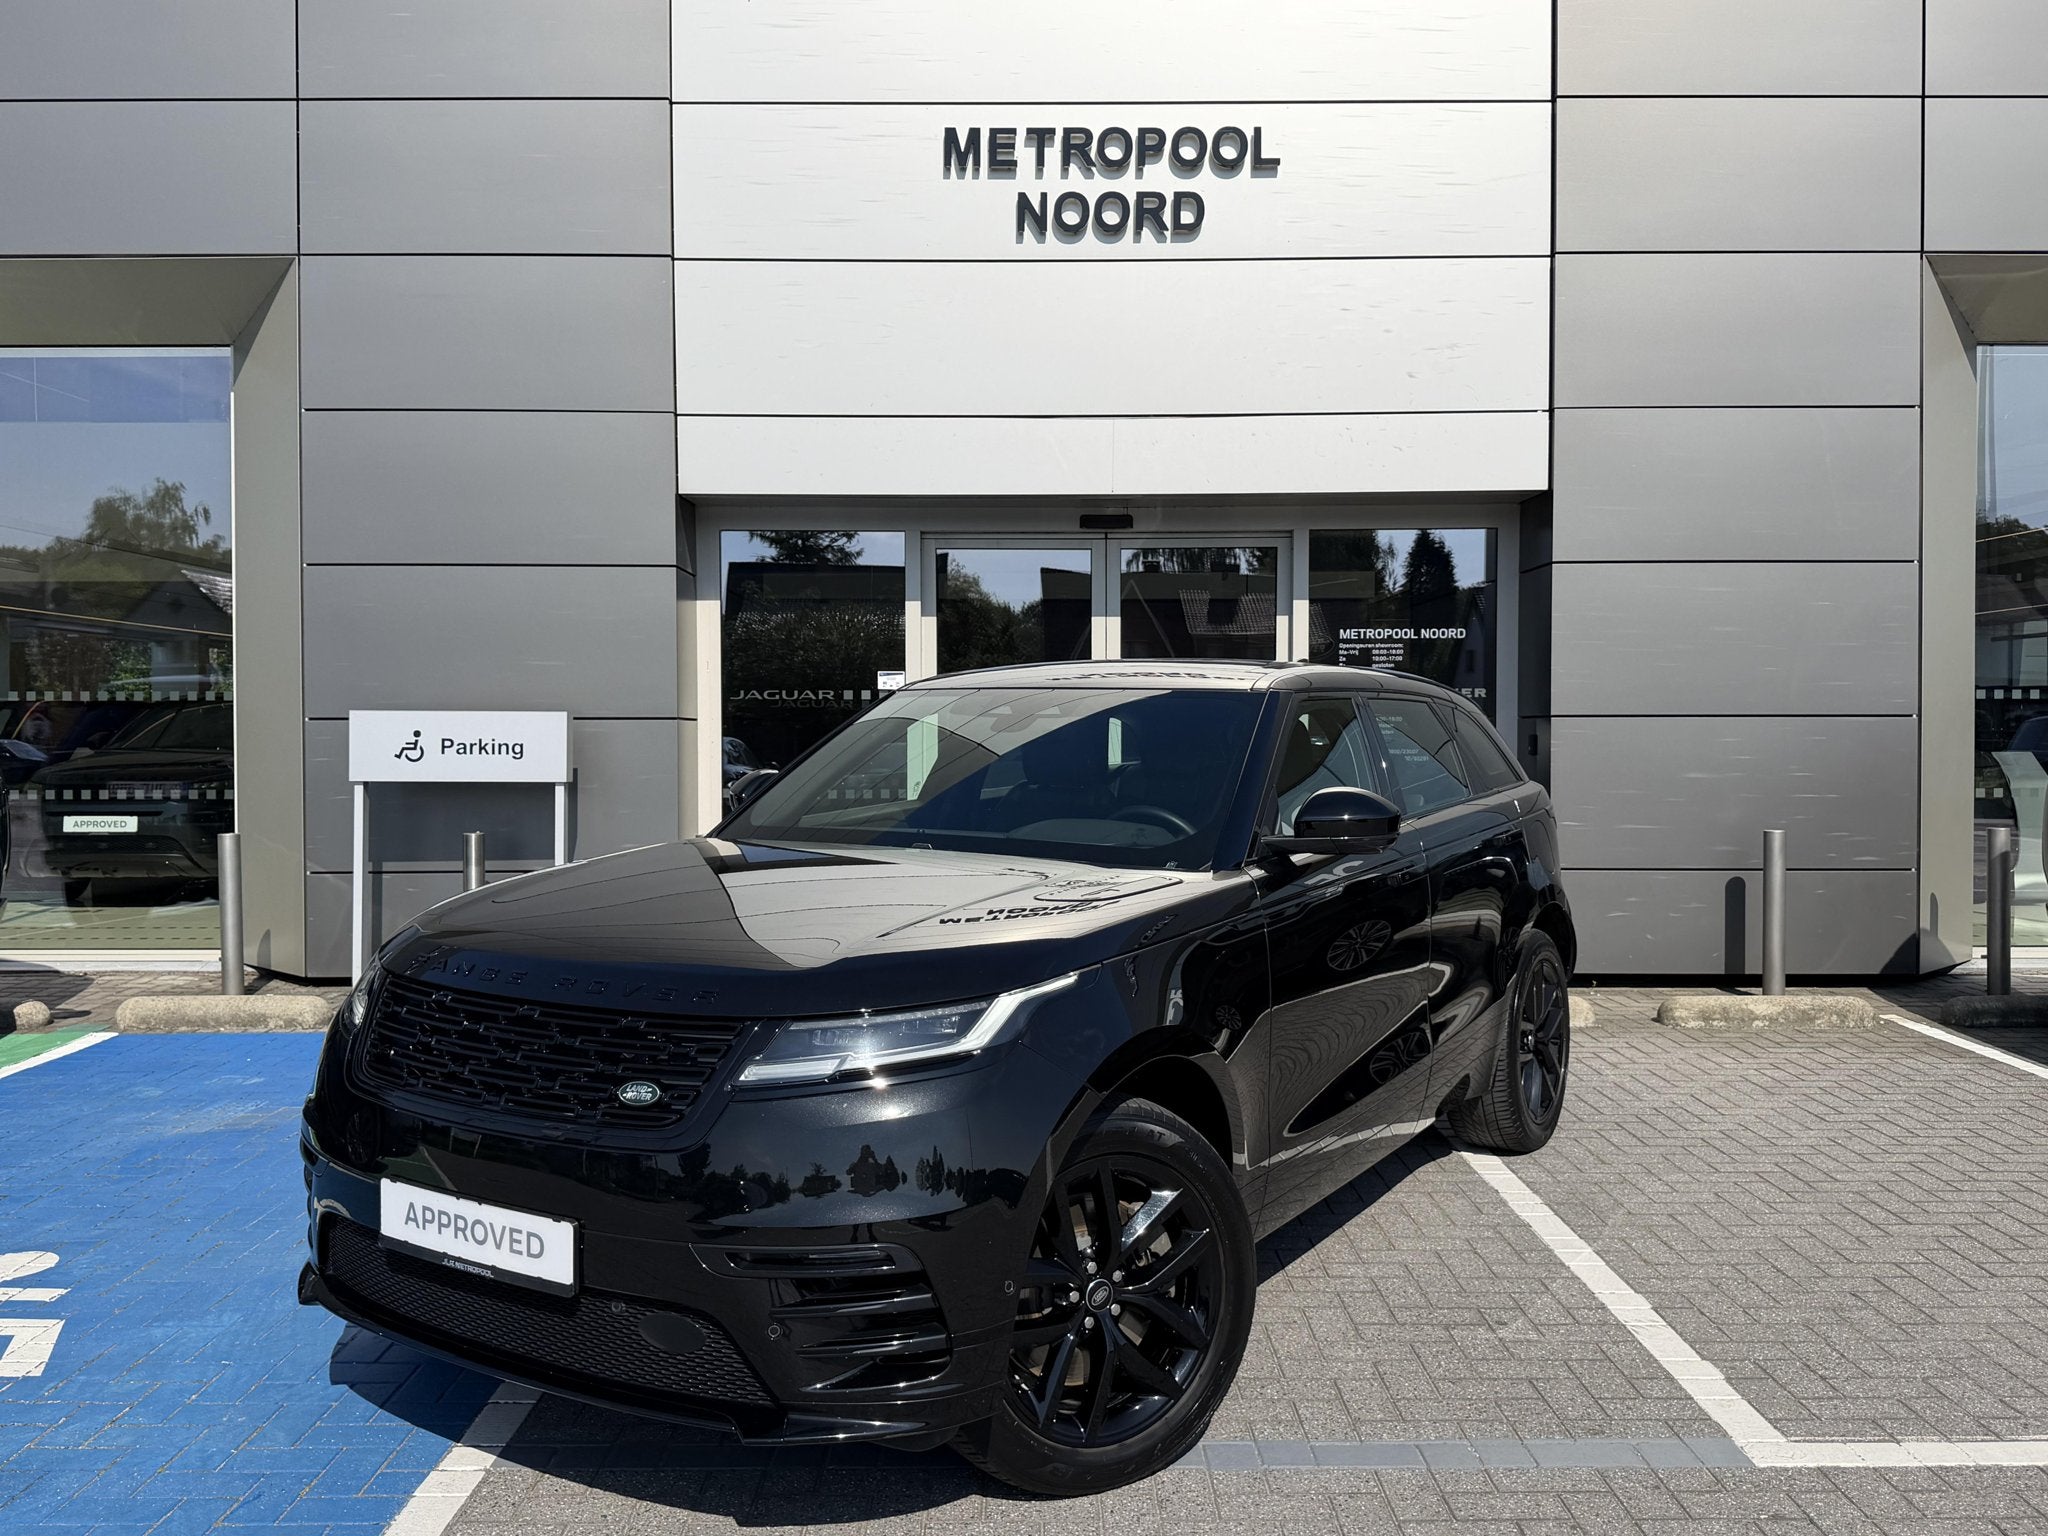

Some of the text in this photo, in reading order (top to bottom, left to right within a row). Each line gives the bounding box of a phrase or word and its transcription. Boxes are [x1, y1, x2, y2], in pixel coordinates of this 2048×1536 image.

[943, 126, 1281, 174] METROPOOL
[1017, 191, 1205, 235] NOORD
[1339, 628, 1466, 640] METROPOOL NOORD
[730, 690, 836, 700] JAGUAR
[1457, 687, 1487, 698] ER
[440, 737, 524, 760] Parking
[72, 820, 128, 829] APPROVED
[404, 945, 720, 1004] RANGE ROVER
[626, 1084, 648, 1093] LAND
[626, 1091, 653, 1101] ROVER
[404, 1201, 545, 1259] APPROVED
[455, 1261, 495, 1278] METROPOOL
